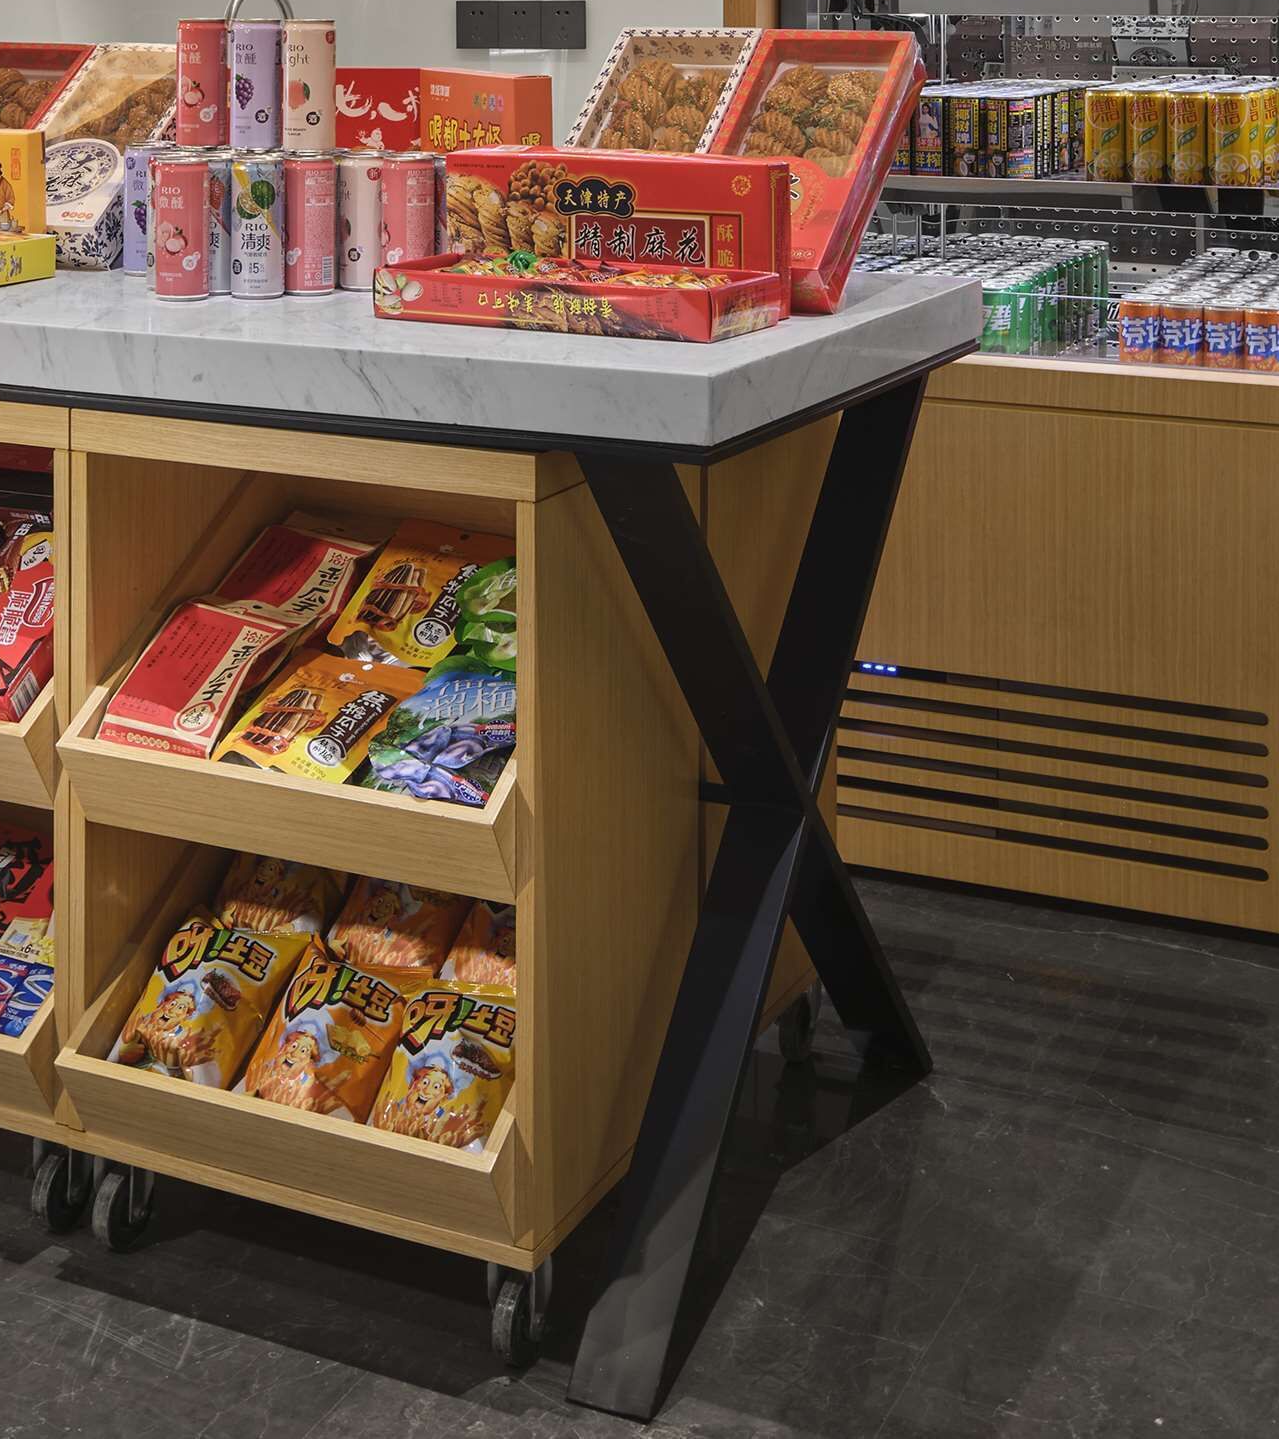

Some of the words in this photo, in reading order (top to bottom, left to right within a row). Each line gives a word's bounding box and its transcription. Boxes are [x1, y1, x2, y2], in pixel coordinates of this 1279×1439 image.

[235, 42, 254, 51] RIO
[1090, 97, 1118, 110] 维他
[1128, 97, 1156, 110] 维他
[1168, 97, 1195, 110] 维他
[1210, 97, 1239, 111] 维他
[428, 113, 503, 153] 哏都十大怪
[135, 170, 147, 178] RI
[158, 195, 185, 210] 微醺
[161, 186, 181, 195] RIO
[563, 186, 628, 211] 天津特产
[245, 223, 269, 232] RIO
[240, 232, 271, 251] 清爽
[574, 222, 706, 265] 精制麻花
[716, 222, 735, 268] 酥脆
[478, 289, 533, 313] 美味可口
[551, 292, 613, 319] 香甜酥脆
[1121, 316, 1160, 344] 芬达
[1161, 317, 1203, 346] 芬达
[1205, 319, 1244, 350] 芬达
[330, 689, 390, 739] 焦糖瓜子
[158, 921, 276, 984] 呀!土豆
[286, 960, 398, 1022] 呀!土豆
[398, 990, 517, 1057] 呀!土豆
